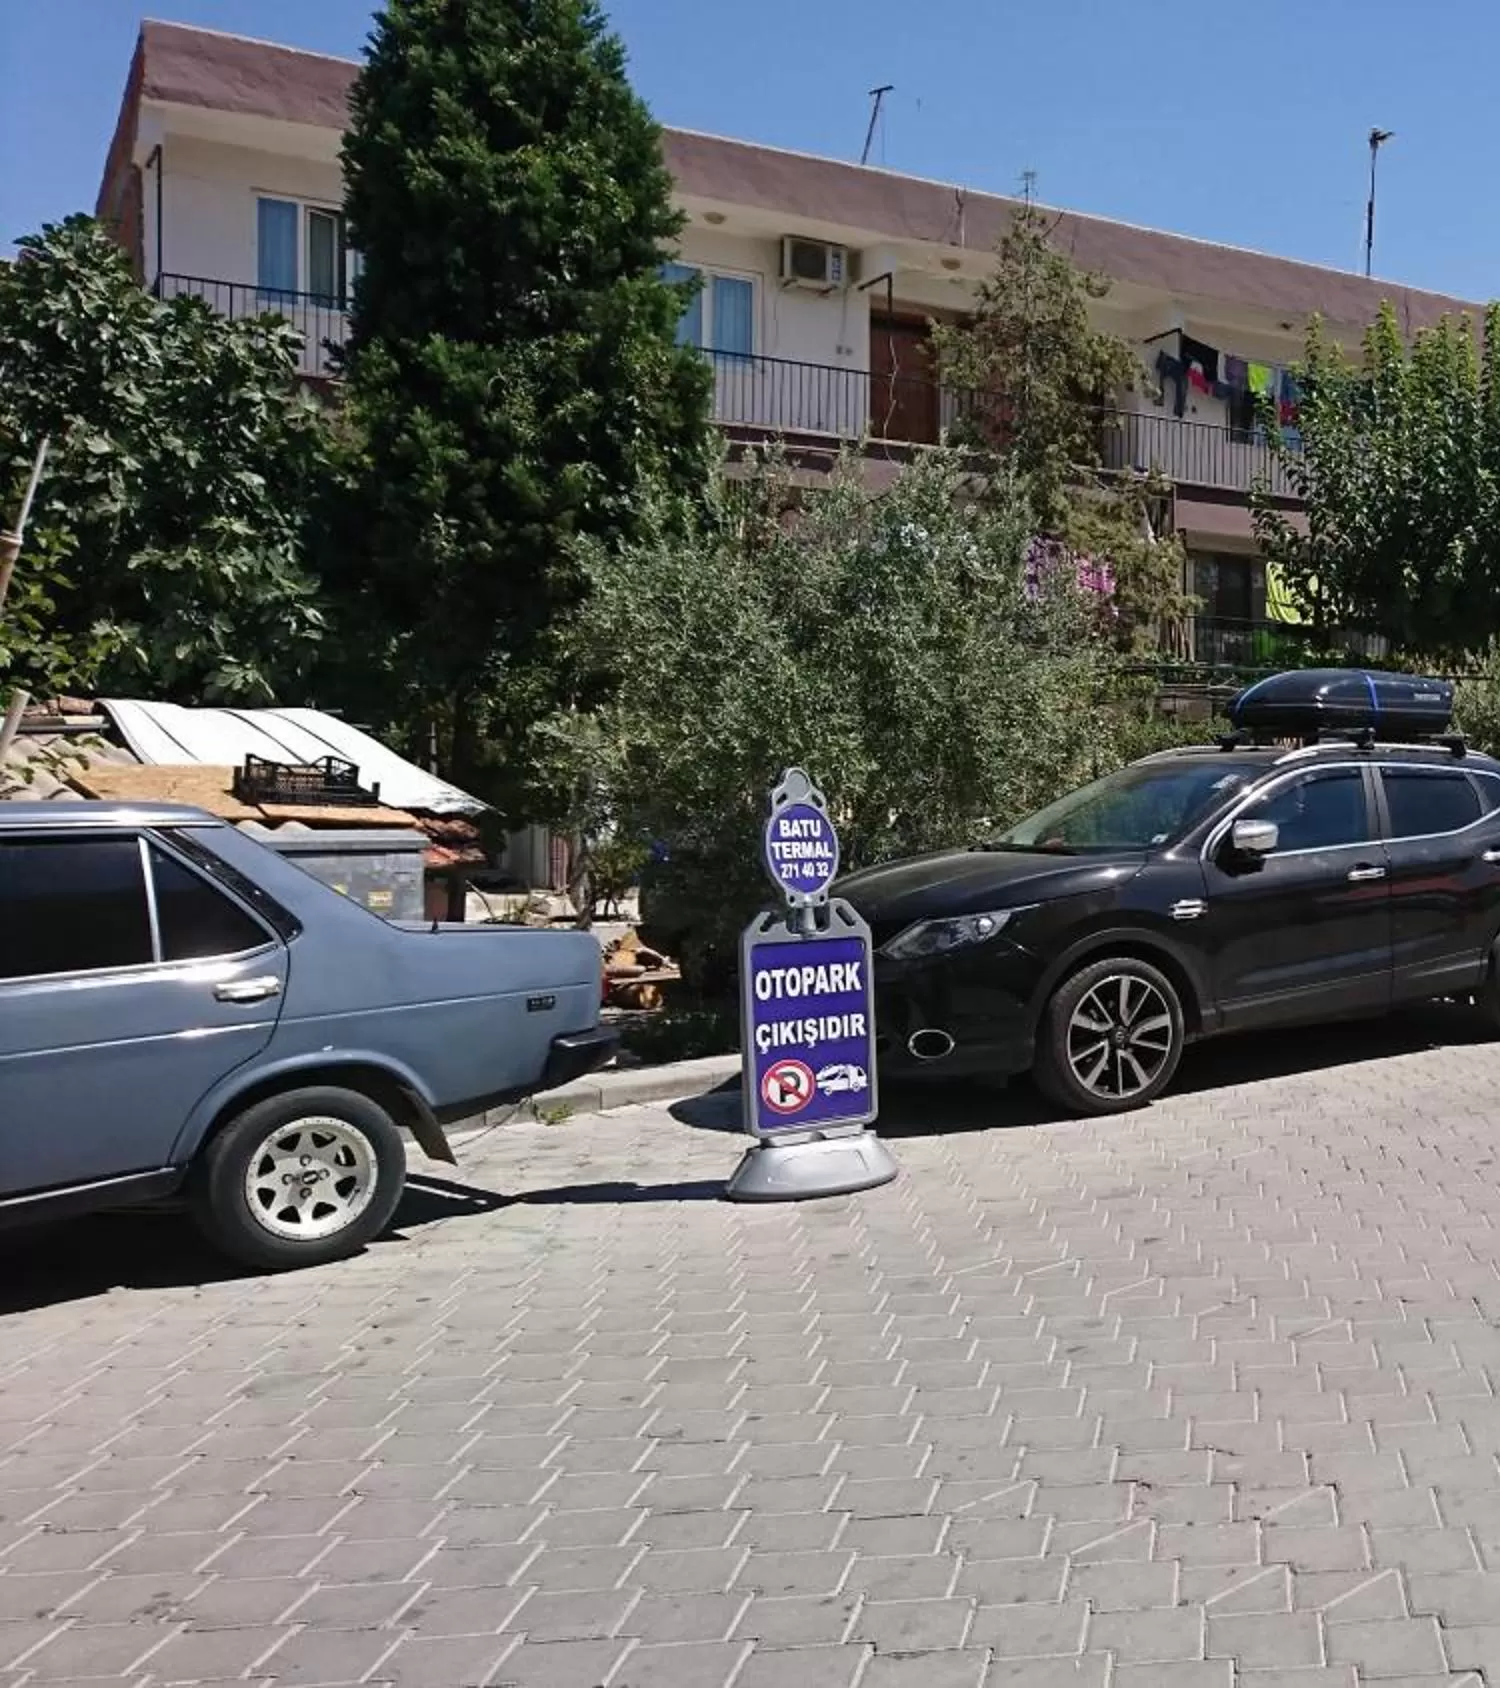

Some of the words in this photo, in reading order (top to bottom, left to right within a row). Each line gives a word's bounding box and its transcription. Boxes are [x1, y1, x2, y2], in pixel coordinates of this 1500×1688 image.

[780, 819, 821, 837] BATU
[771, 841, 833, 860] TERMAL
[781, 863, 799, 879] 271
[802, 862, 815, 878] 40
[816, 862, 829, 877] 32
[755, 961, 862, 1001] OTOPARK
[755, 1013, 866, 1054] ÇIKIŞIDIR
